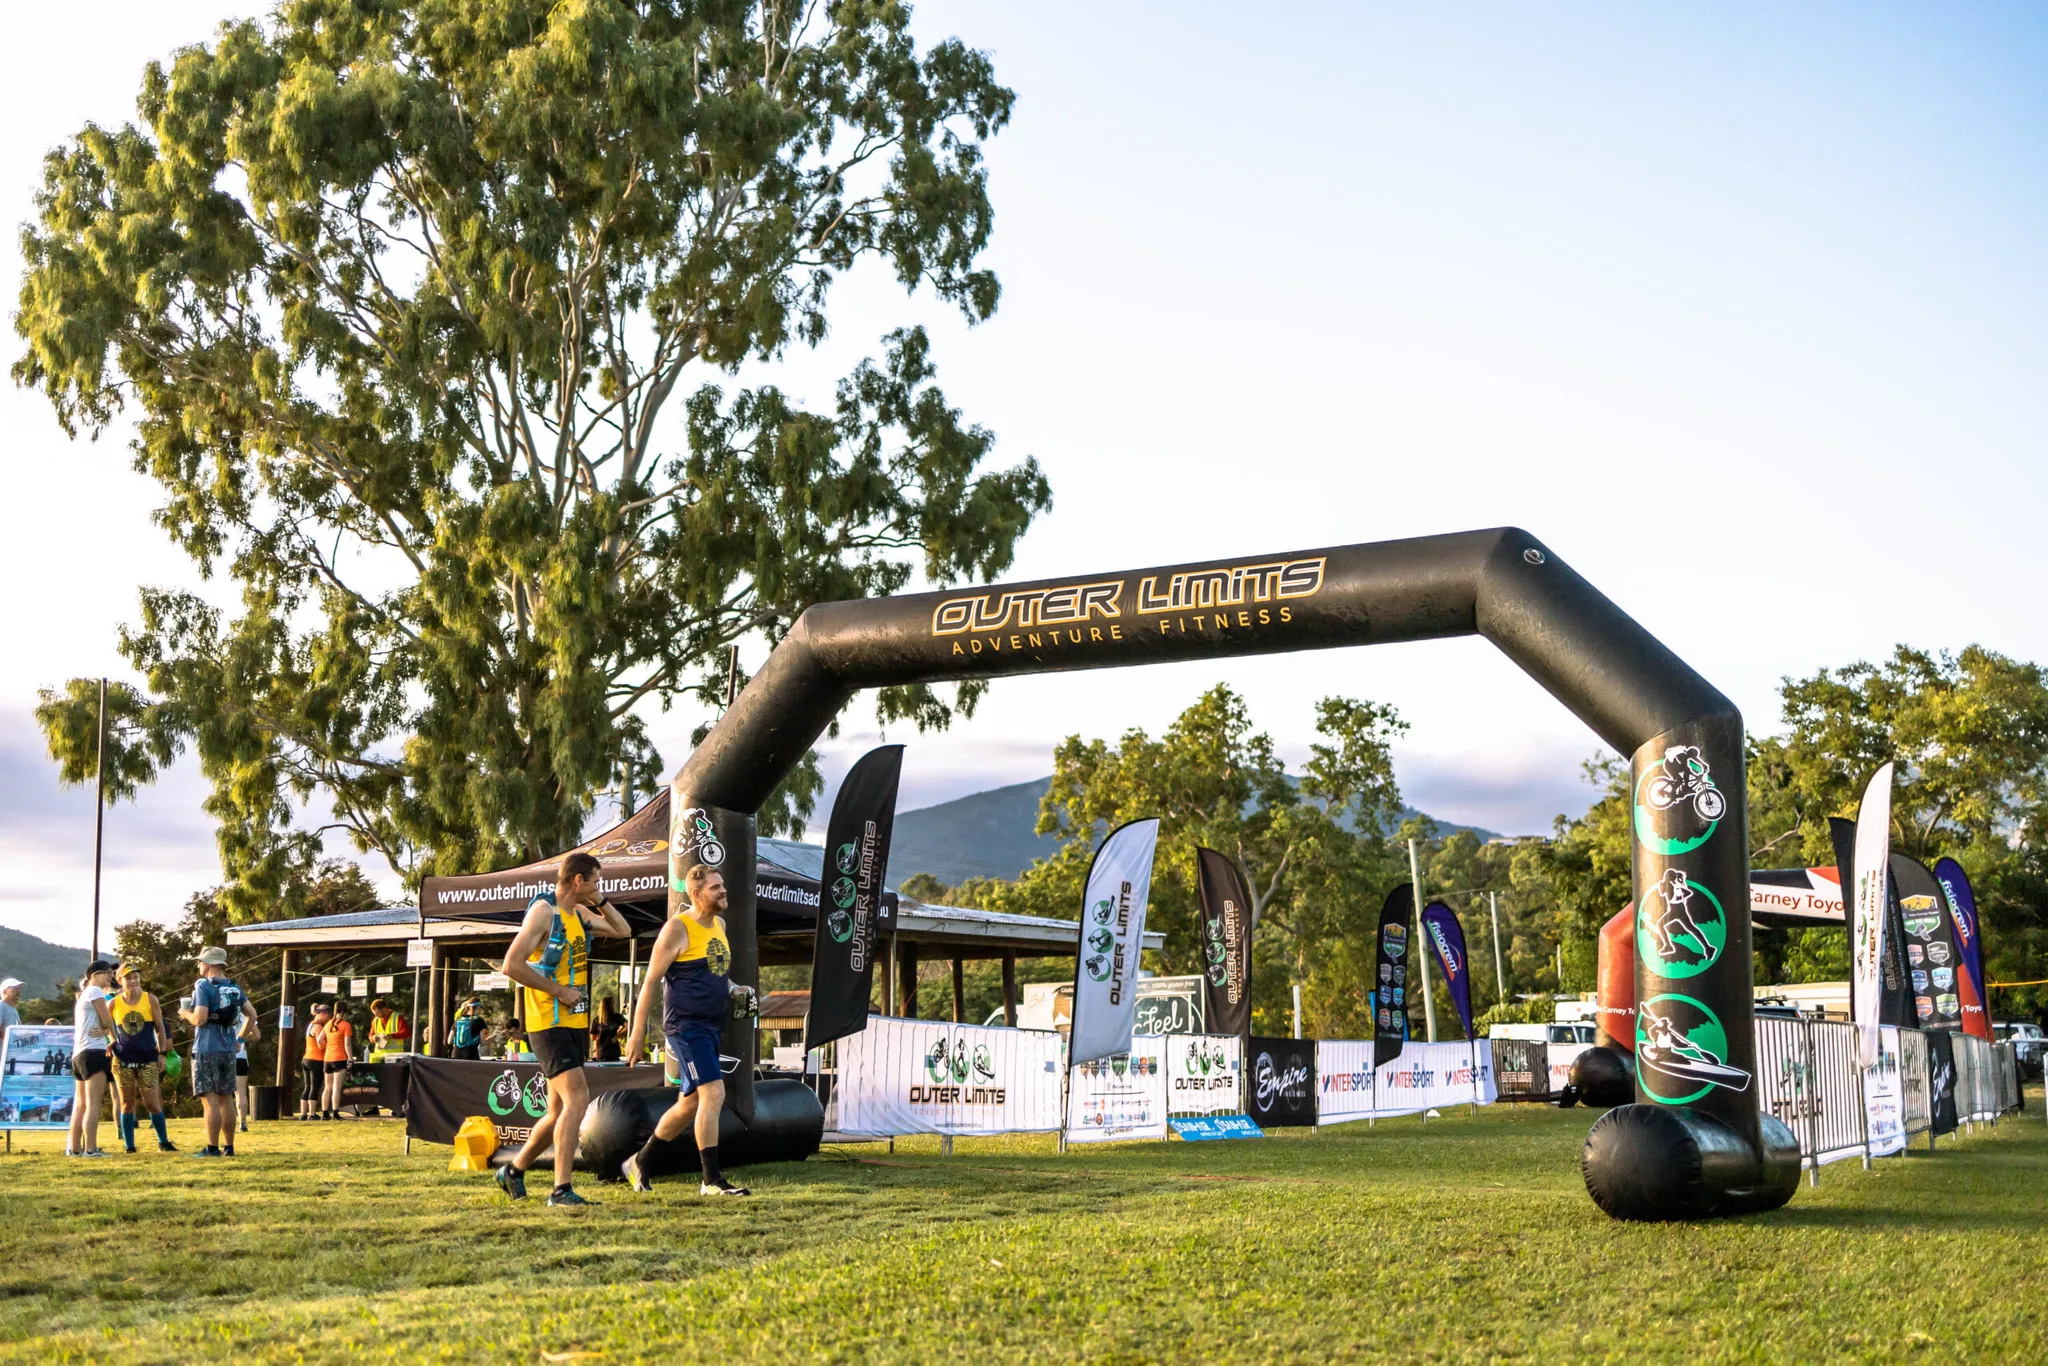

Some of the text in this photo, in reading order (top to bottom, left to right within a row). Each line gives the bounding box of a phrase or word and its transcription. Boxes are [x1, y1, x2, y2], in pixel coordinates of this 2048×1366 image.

[932, 580, 1124, 636] OUTER
[952, 607, 1292, 655] ADVENTURE FITNESS
[1943, 879, 1970, 938] fisiocrem
[409, 943, 431, 951] TIMING
[850, 894, 870, 972] OUTER
[1431, 921, 1458, 972] fisiocrem
[1110, 943, 1125, 1006] OUTER
[1226, 950, 1238, 1004] OUTER
[1137, 1000, 1183, 1035] Feel
[910, 1085, 960, 1105] OUTER
[1175, 1078, 1206, 1091] OUTER
[1257, 1066, 1308, 1099] Empire
[1394, 1070, 1434, 1088] INTERSPORT
